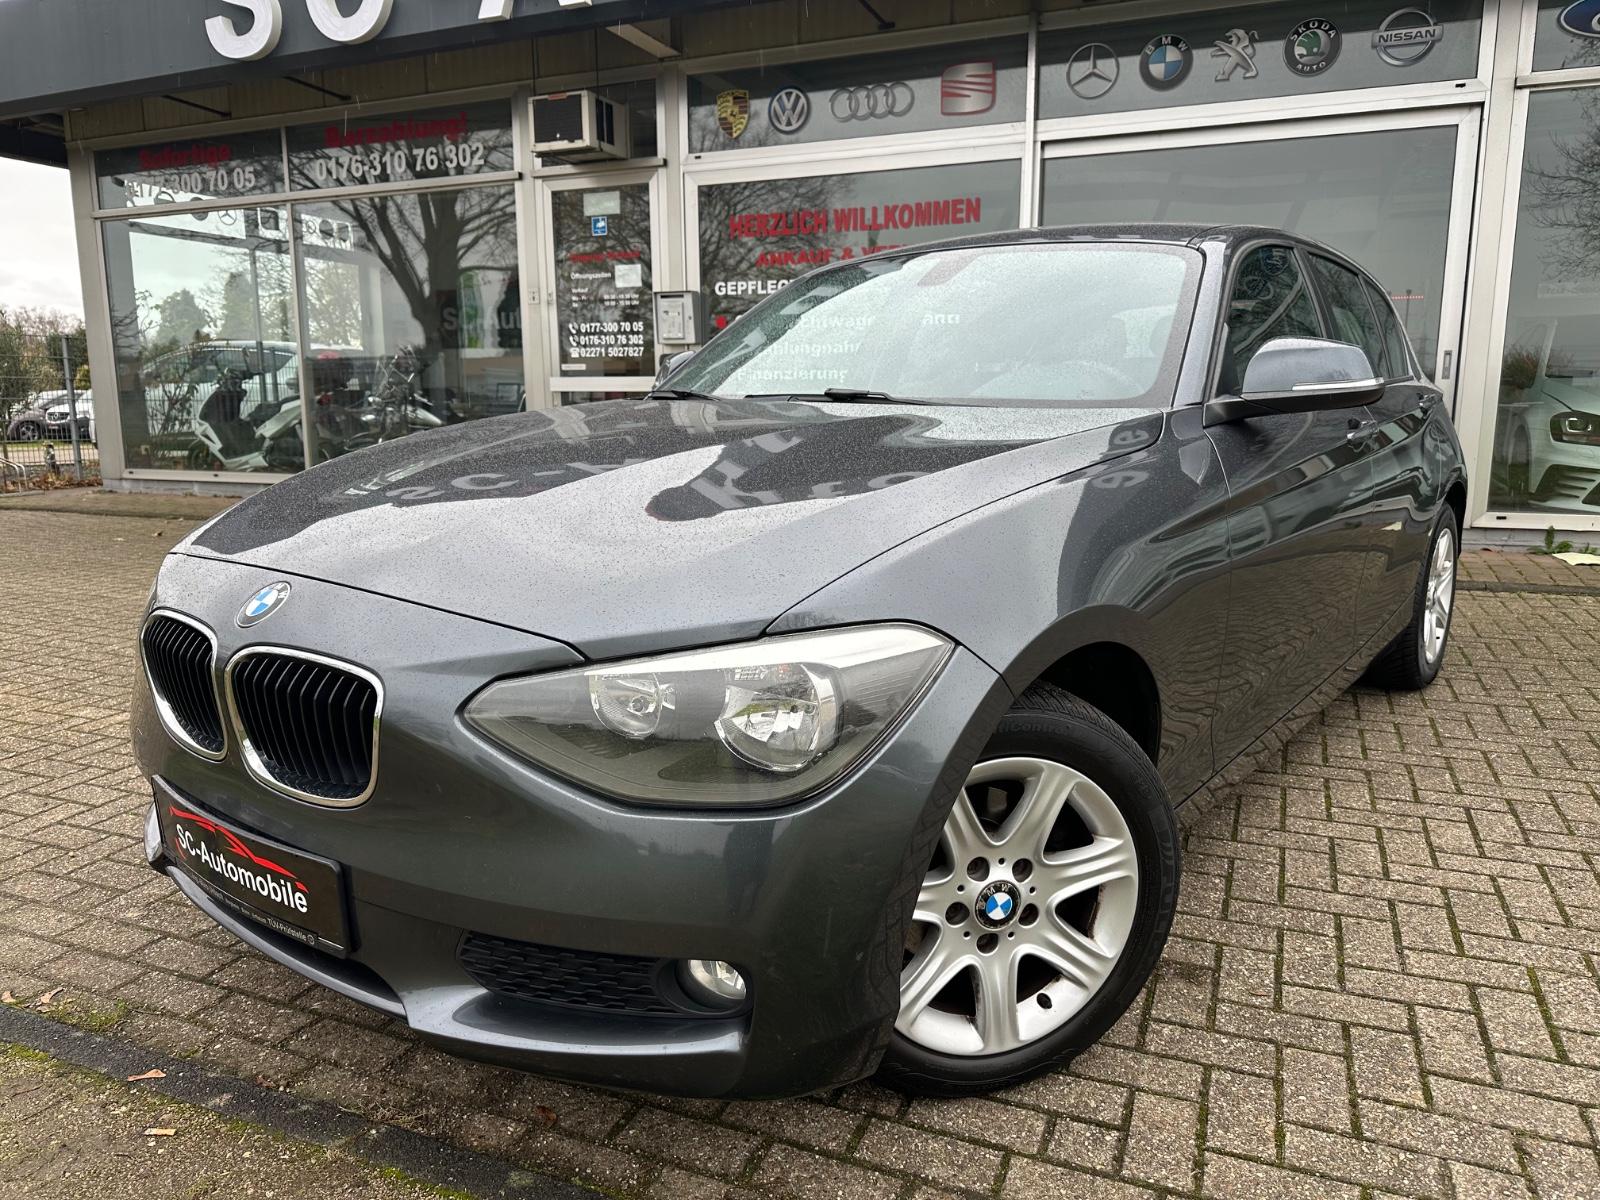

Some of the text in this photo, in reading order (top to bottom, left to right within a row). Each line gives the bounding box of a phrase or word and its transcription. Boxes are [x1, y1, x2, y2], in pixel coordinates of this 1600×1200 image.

[1290, 20, 1337, 41] SKODA
[1378, 28, 1437, 43] NISSAN
[1144, 36, 1189, 55] BMW
[1296, 60, 1327, 72] AUTO
[315, 142, 486, 181] 0176-310 76 302
[205, 167, 229, 192] 70
[232, 166, 256, 189] 05
[729, 197, 982, 241] HERZLICH WILLKOMMEN
[755, 246, 834, 269] ANKAUF
[580, 321, 644, 333] 0177-300 70 05
[580, 334, 644, 345] 0176-310 76 302
[580, 347, 644, 358] 02271 5027827
[176, 823, 309, 914] SC-Automobile
[976, 883, 1010, 911] BMW
